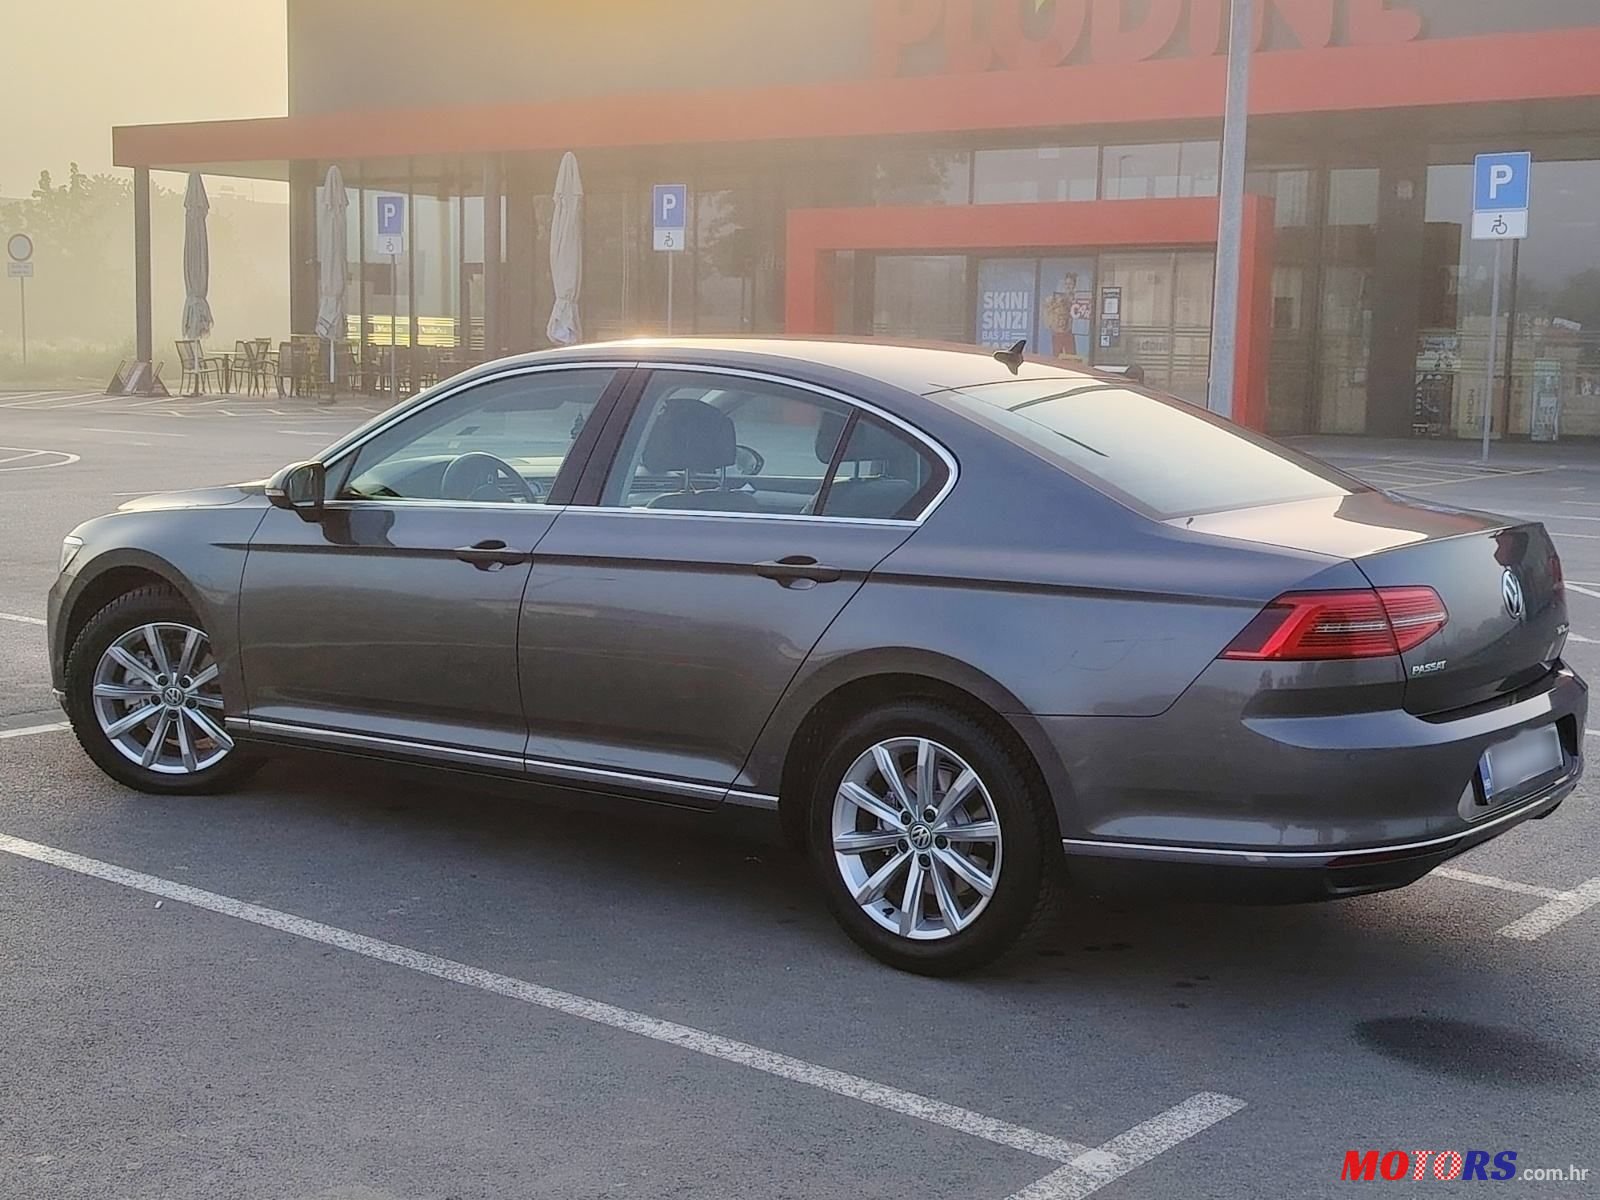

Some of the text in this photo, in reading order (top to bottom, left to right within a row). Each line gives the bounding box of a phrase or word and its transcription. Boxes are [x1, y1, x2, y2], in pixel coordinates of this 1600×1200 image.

[1489, 164, 1513, 200] P
[384, 203, 396, 227] P
[663, 193, 677, 220] P
[983, 291, 1028, 309] SKINI
[982, 310, 1028, 329] SNIZI
[1411, 660, 1447, 675] PASSAT
